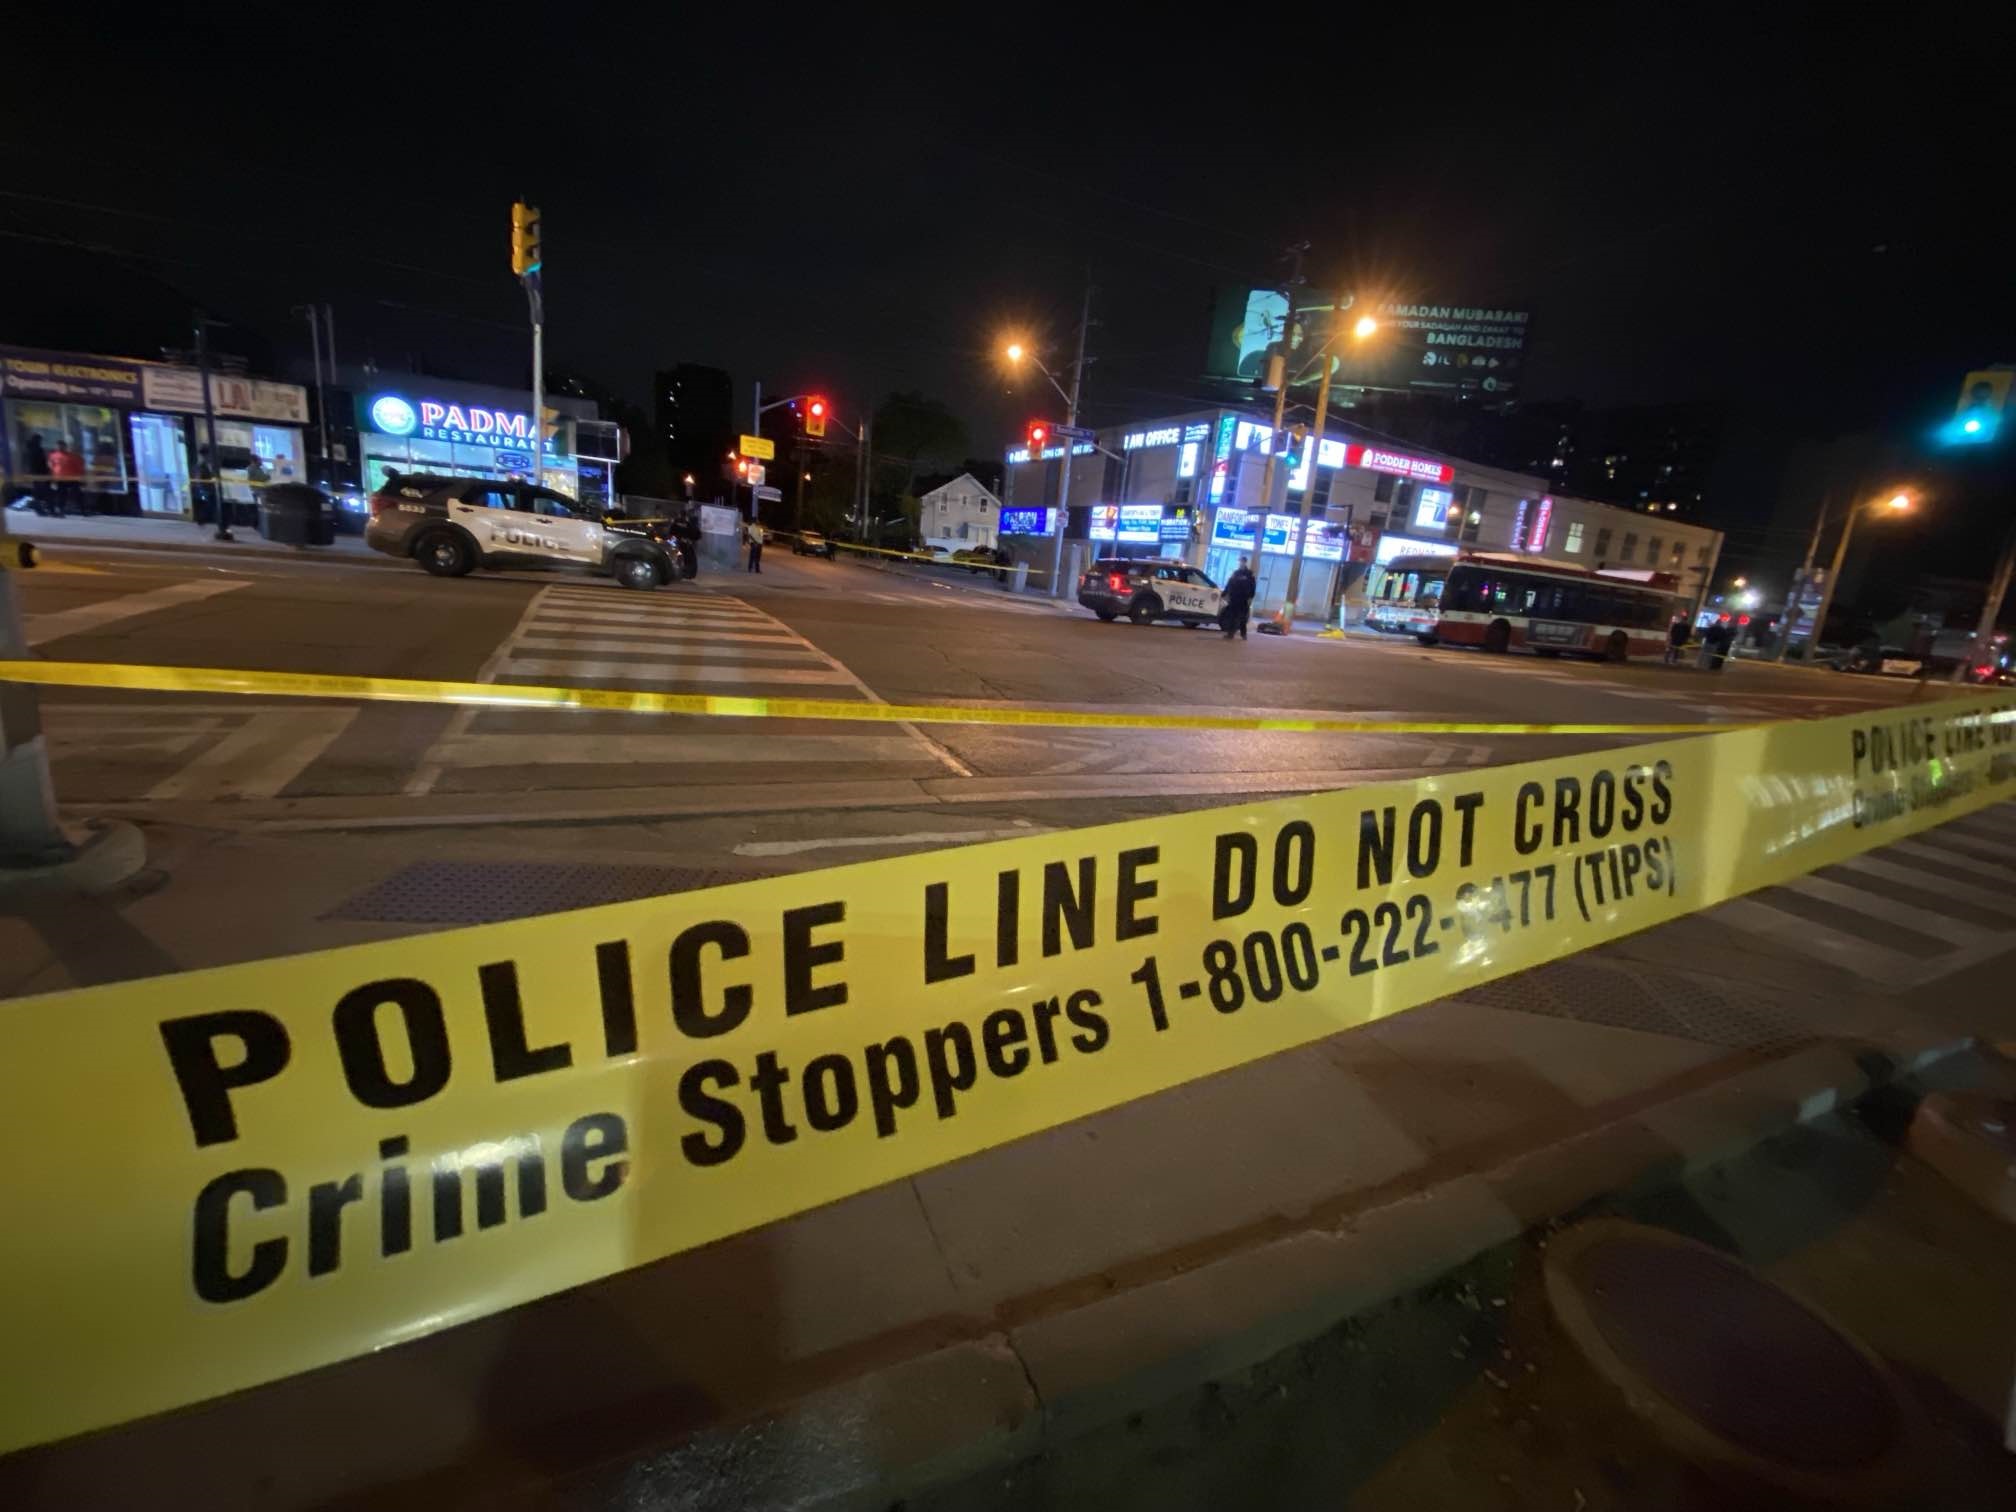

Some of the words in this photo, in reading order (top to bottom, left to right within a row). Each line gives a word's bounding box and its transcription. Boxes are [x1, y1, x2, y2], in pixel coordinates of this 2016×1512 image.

[1427, 332, 1522, 349] BANGLADESH
[1145, 427, 1181, 446] OFFICE
[1411, 460, 1443, 476] HOMES
[1168, 594, 1204, 609] POLICE
[1852, 716, 1936, 780] POLICE
[159, 901, 849, 1148] POLICE
[925, 845, 1160, 985] LINE
[1213, 820, 1315, 921] DO
[1357, 791, 1484, 890] NOT
[1513, 760, 1674, 856] CROSS
[192, 1110, 631, 1304] Crime
[677, 988, 1111, 1168] Stoppers
[1574, 835, 1676, 922] (TIPS)
